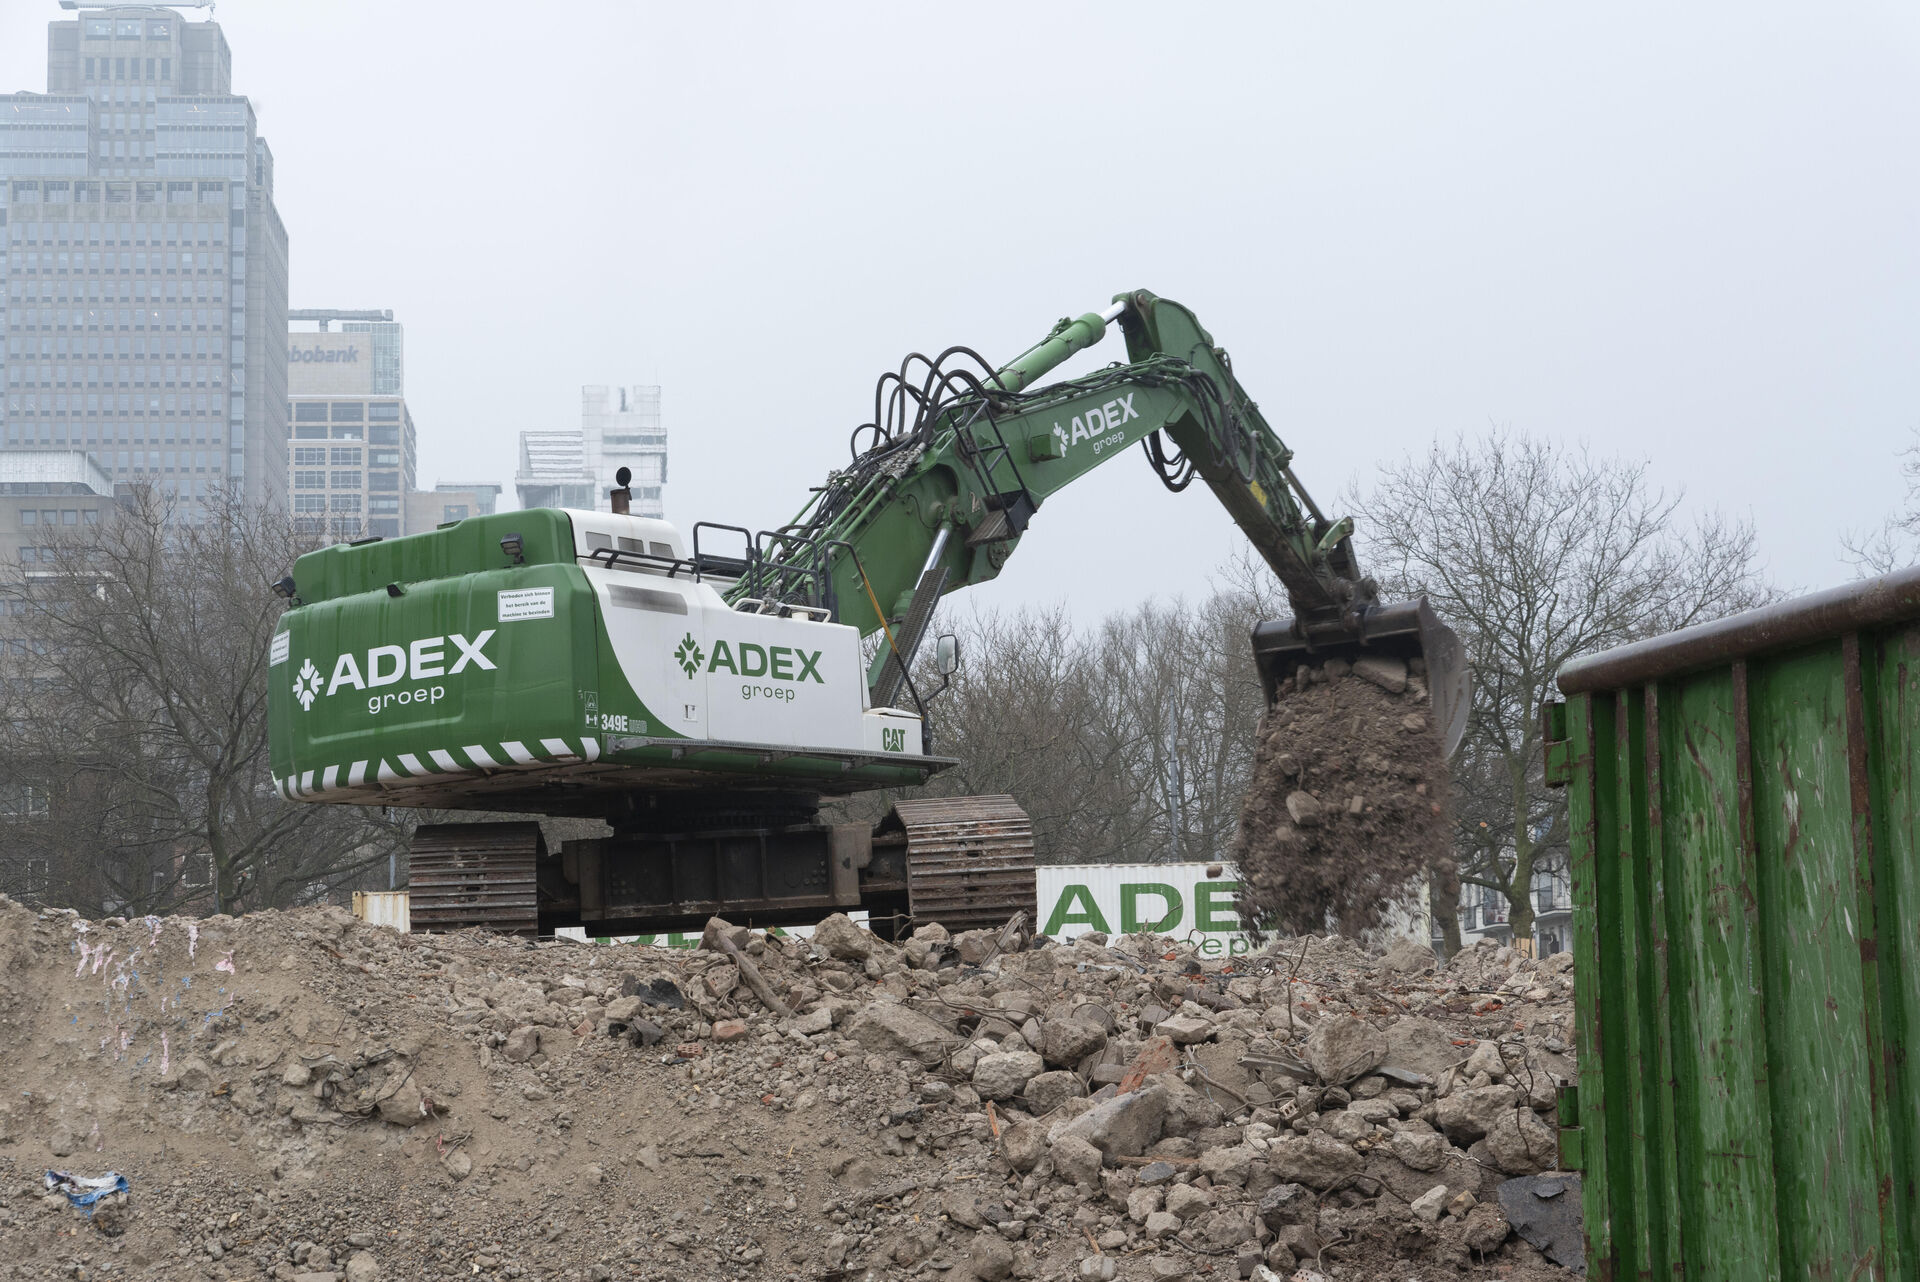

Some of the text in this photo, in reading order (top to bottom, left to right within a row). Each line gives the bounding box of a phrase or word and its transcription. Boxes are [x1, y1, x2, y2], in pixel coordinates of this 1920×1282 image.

[288, 345, 359, 363] bobank
[1071, 392, 1140, 446] ADEX
[1093, 431, 1125, 454] groep
[326, 629, 498, 697] ADEX
[707, 640, 825, 684] ADEX
[368, 685, 445, 714] groep
[741, 684, 795, 703] groep
[601, 714, 628, 732] 349E
[882, 727, 906, 752] CAT
[1043, 881, 1279, 935] ADE
